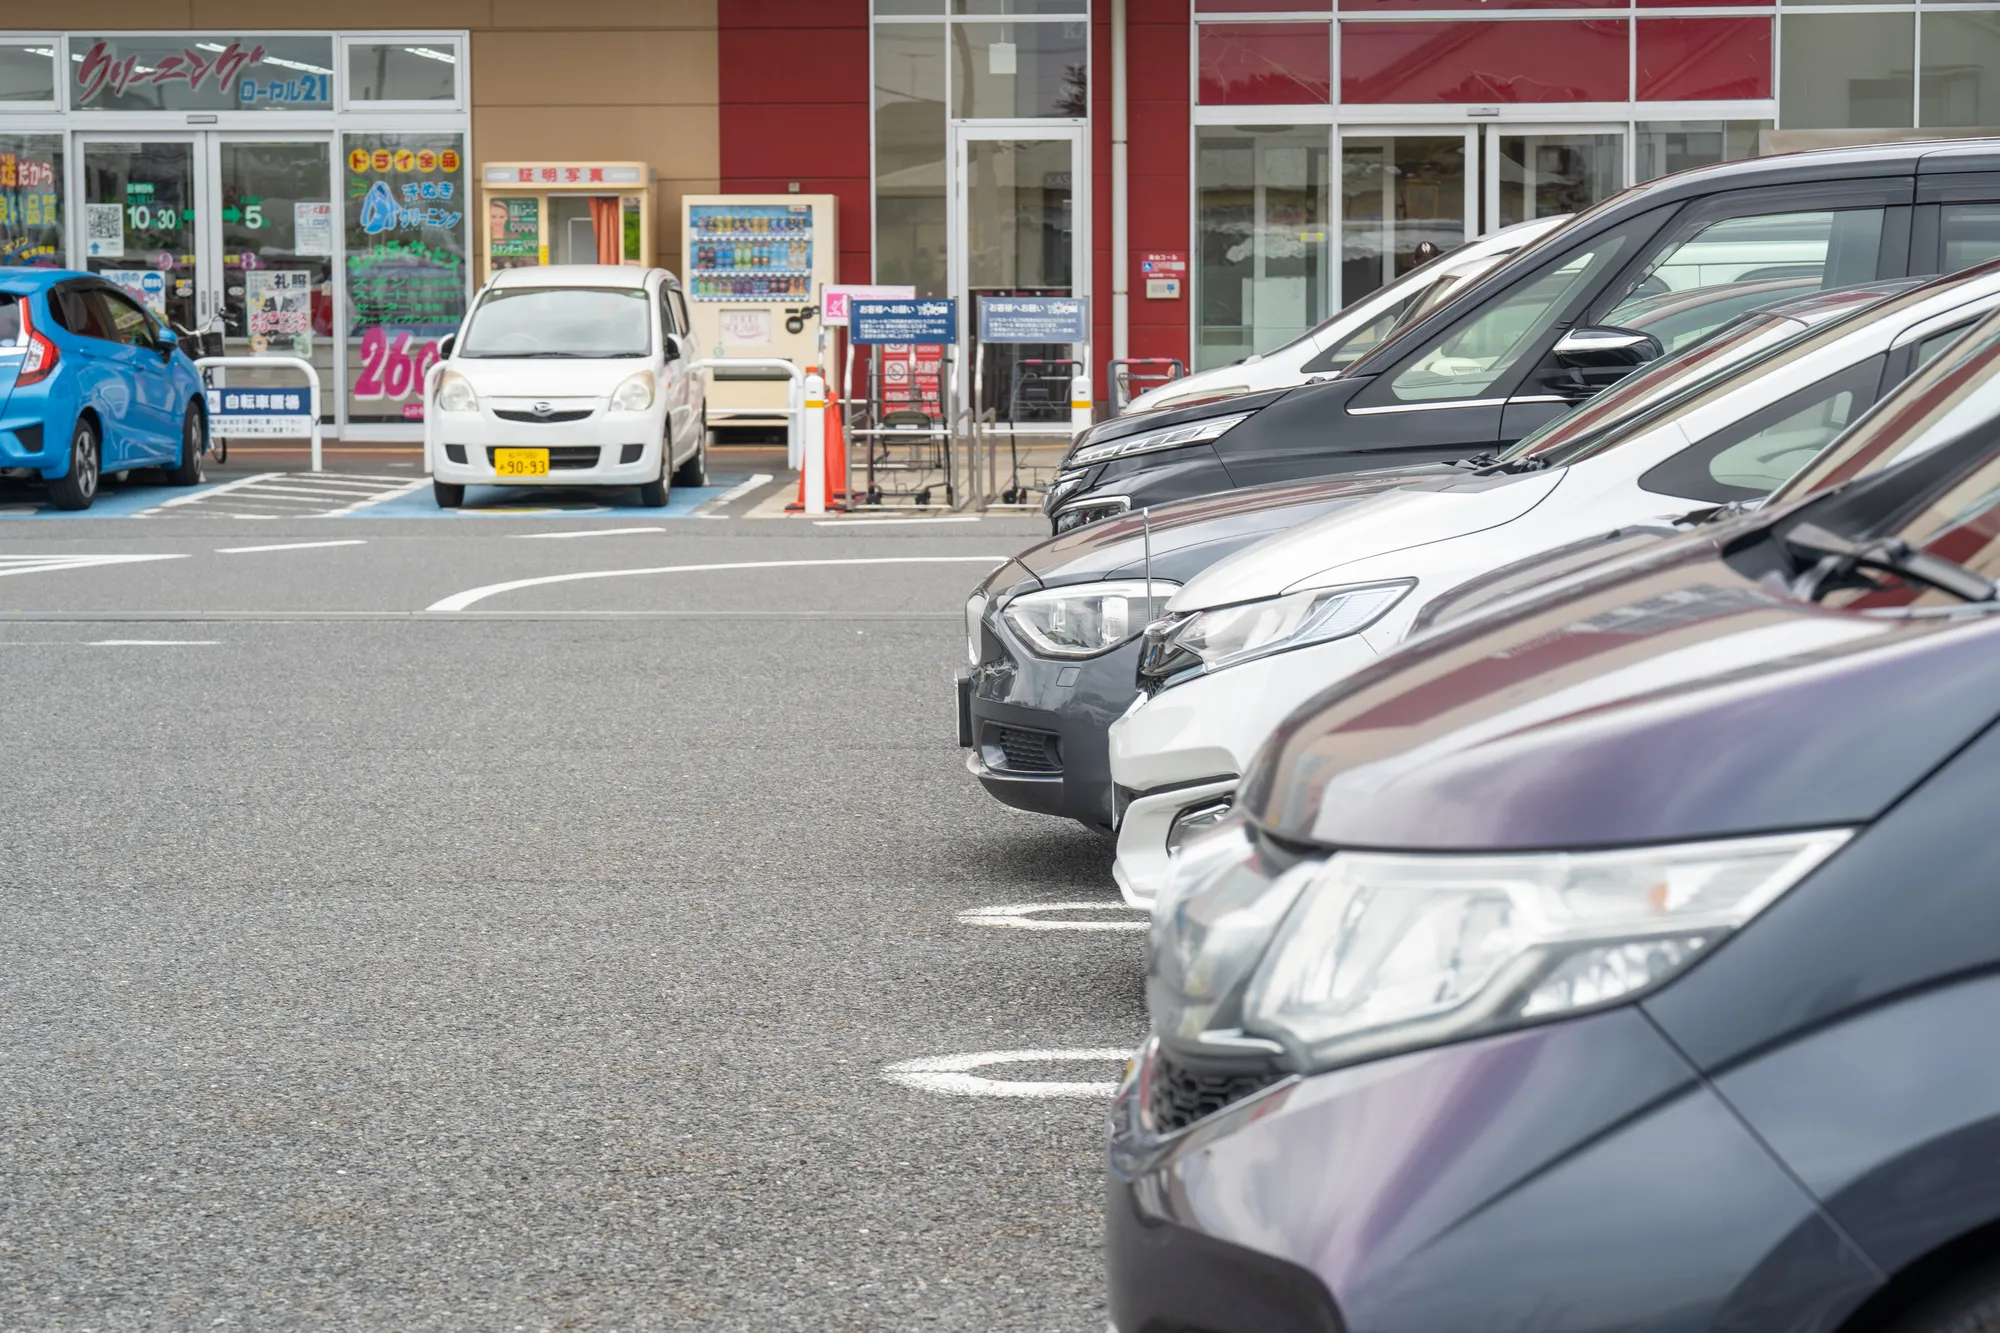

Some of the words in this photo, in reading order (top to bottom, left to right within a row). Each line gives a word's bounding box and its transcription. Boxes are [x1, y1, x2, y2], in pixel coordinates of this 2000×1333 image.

[78, 41, 266, 102] クリーニング
[239, 74, 330, 103] ローヤル21
[351, 150, 457, 171] ドライ全品
[518, 168, 604, 182] 証明写真
[402, 182, 453, 201] 汗ぬき
[399, 208, 462, 228] クリーニング
[273, 273, 307, 289] 礼服
[251, 311, 307, 322] メンテナンス
[251, 321, 307, 333] クリーニング
[225, 394, 300, 410] 自転車置場
[508, 460, 545, 474] 90-93
